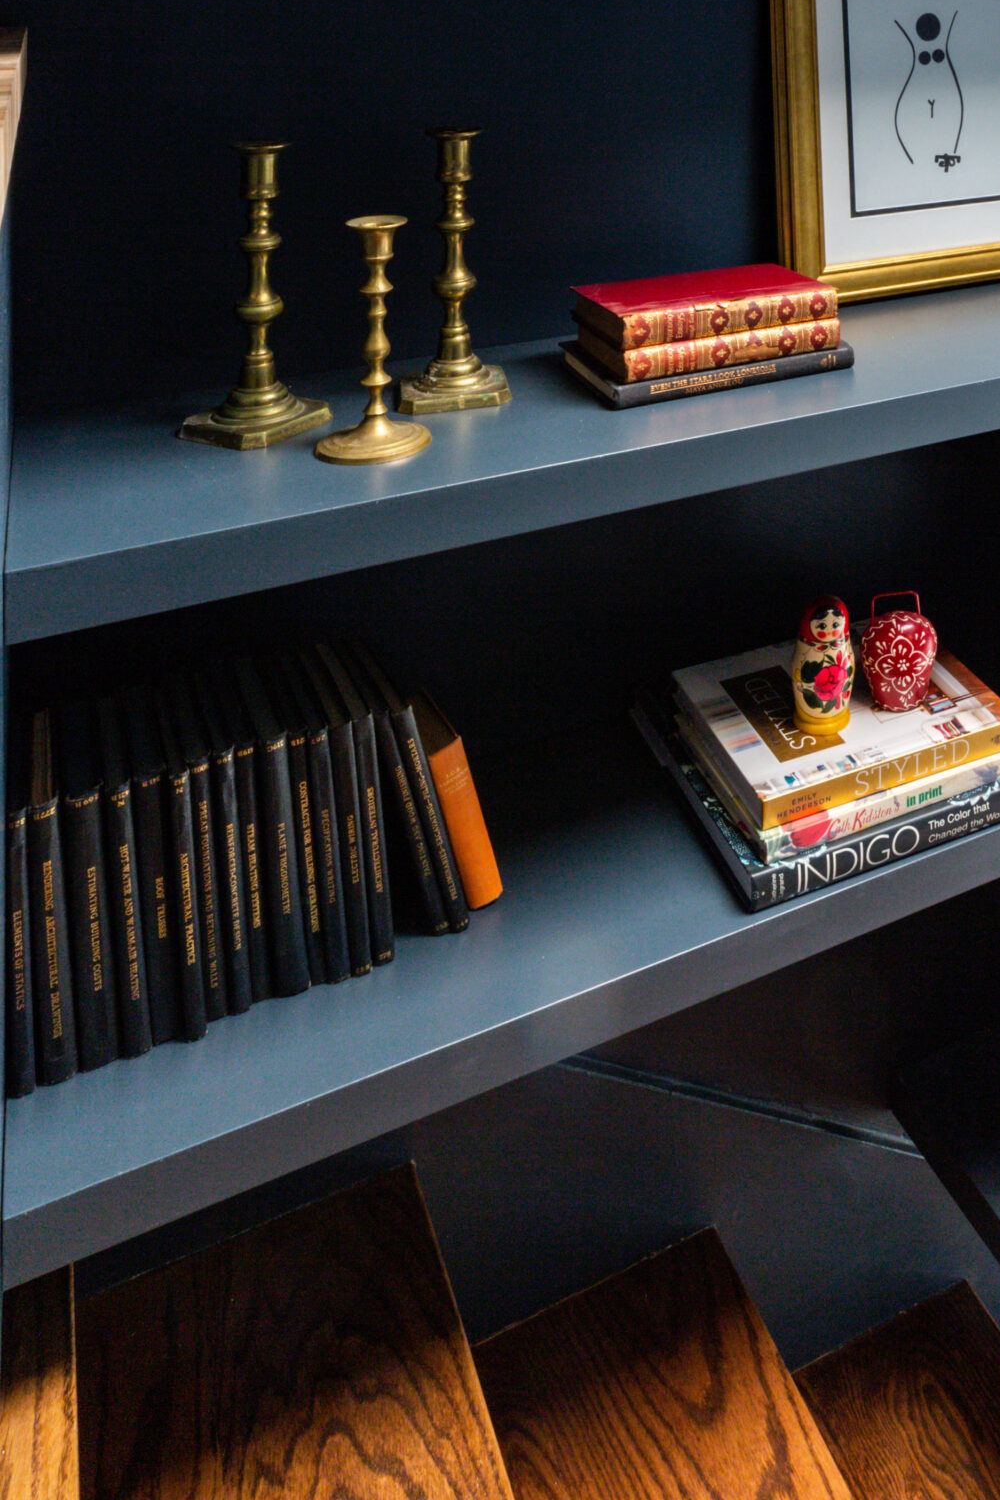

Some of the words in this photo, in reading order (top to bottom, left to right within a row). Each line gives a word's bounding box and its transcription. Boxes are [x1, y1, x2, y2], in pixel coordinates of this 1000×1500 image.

[650, 380, 671, 393] EVEN
[671, 378, 688, 389] THE
[689, 373, 713, 386] STARS
[713, 370, 736, 382] LOOK
[736, 363, 777, 377] LONESOME
[685, 384, 707, 394] MAYA
[854, 738, 972, 797] STYLED
[299, 780, 311, 829] CONTRACTS
[776, 795, 832, 821] HENDERSON
[791, 791, 818, 806] EMILY
[906, 796, 917, 808] in
[918, 785, 943, 805] print
[827, 818, 851, 841] Cath
[927, 822, 969, 845] Changed
[969, 816, 985, 830] the
[928, 816, 946, 831] The
[947, 808, 972, 824] Color
[972, 801, 991, 815] that
[246, 822, 257, 853] STEAM
[277, 822, 288, 850] PLANE
[302, 830, 312, 845] FOR
[248, 854, 259, 892] HEATING
[304, 846, 316, 884] BUILDING
[349, 846, 360, 885] ELECTRIC
[369, 829, 383, 893] ARCHITECTURAL
[797, 825, 920, 893] INDIGO
[43, 859, 54, 911] RENDERING
[87, 865, 98, 920] ESTIMATING
[154, 876, 165, 900] ROOF
[179, 852, 193, 922] ARCHITECTURAL
[279, 851, 292, 916] TRIGONOMETRY
[156, 903, 168, 939] TRUSSES
[251, 892, 261, 929] SYSTEMS
[45, 915, 59, 989] ARCHITECTURAL
[90, 922, 101, 962] BUILDING
[184, 923, 196, 966] PRACTICE
[92, 963, 103, 992] COSTS
